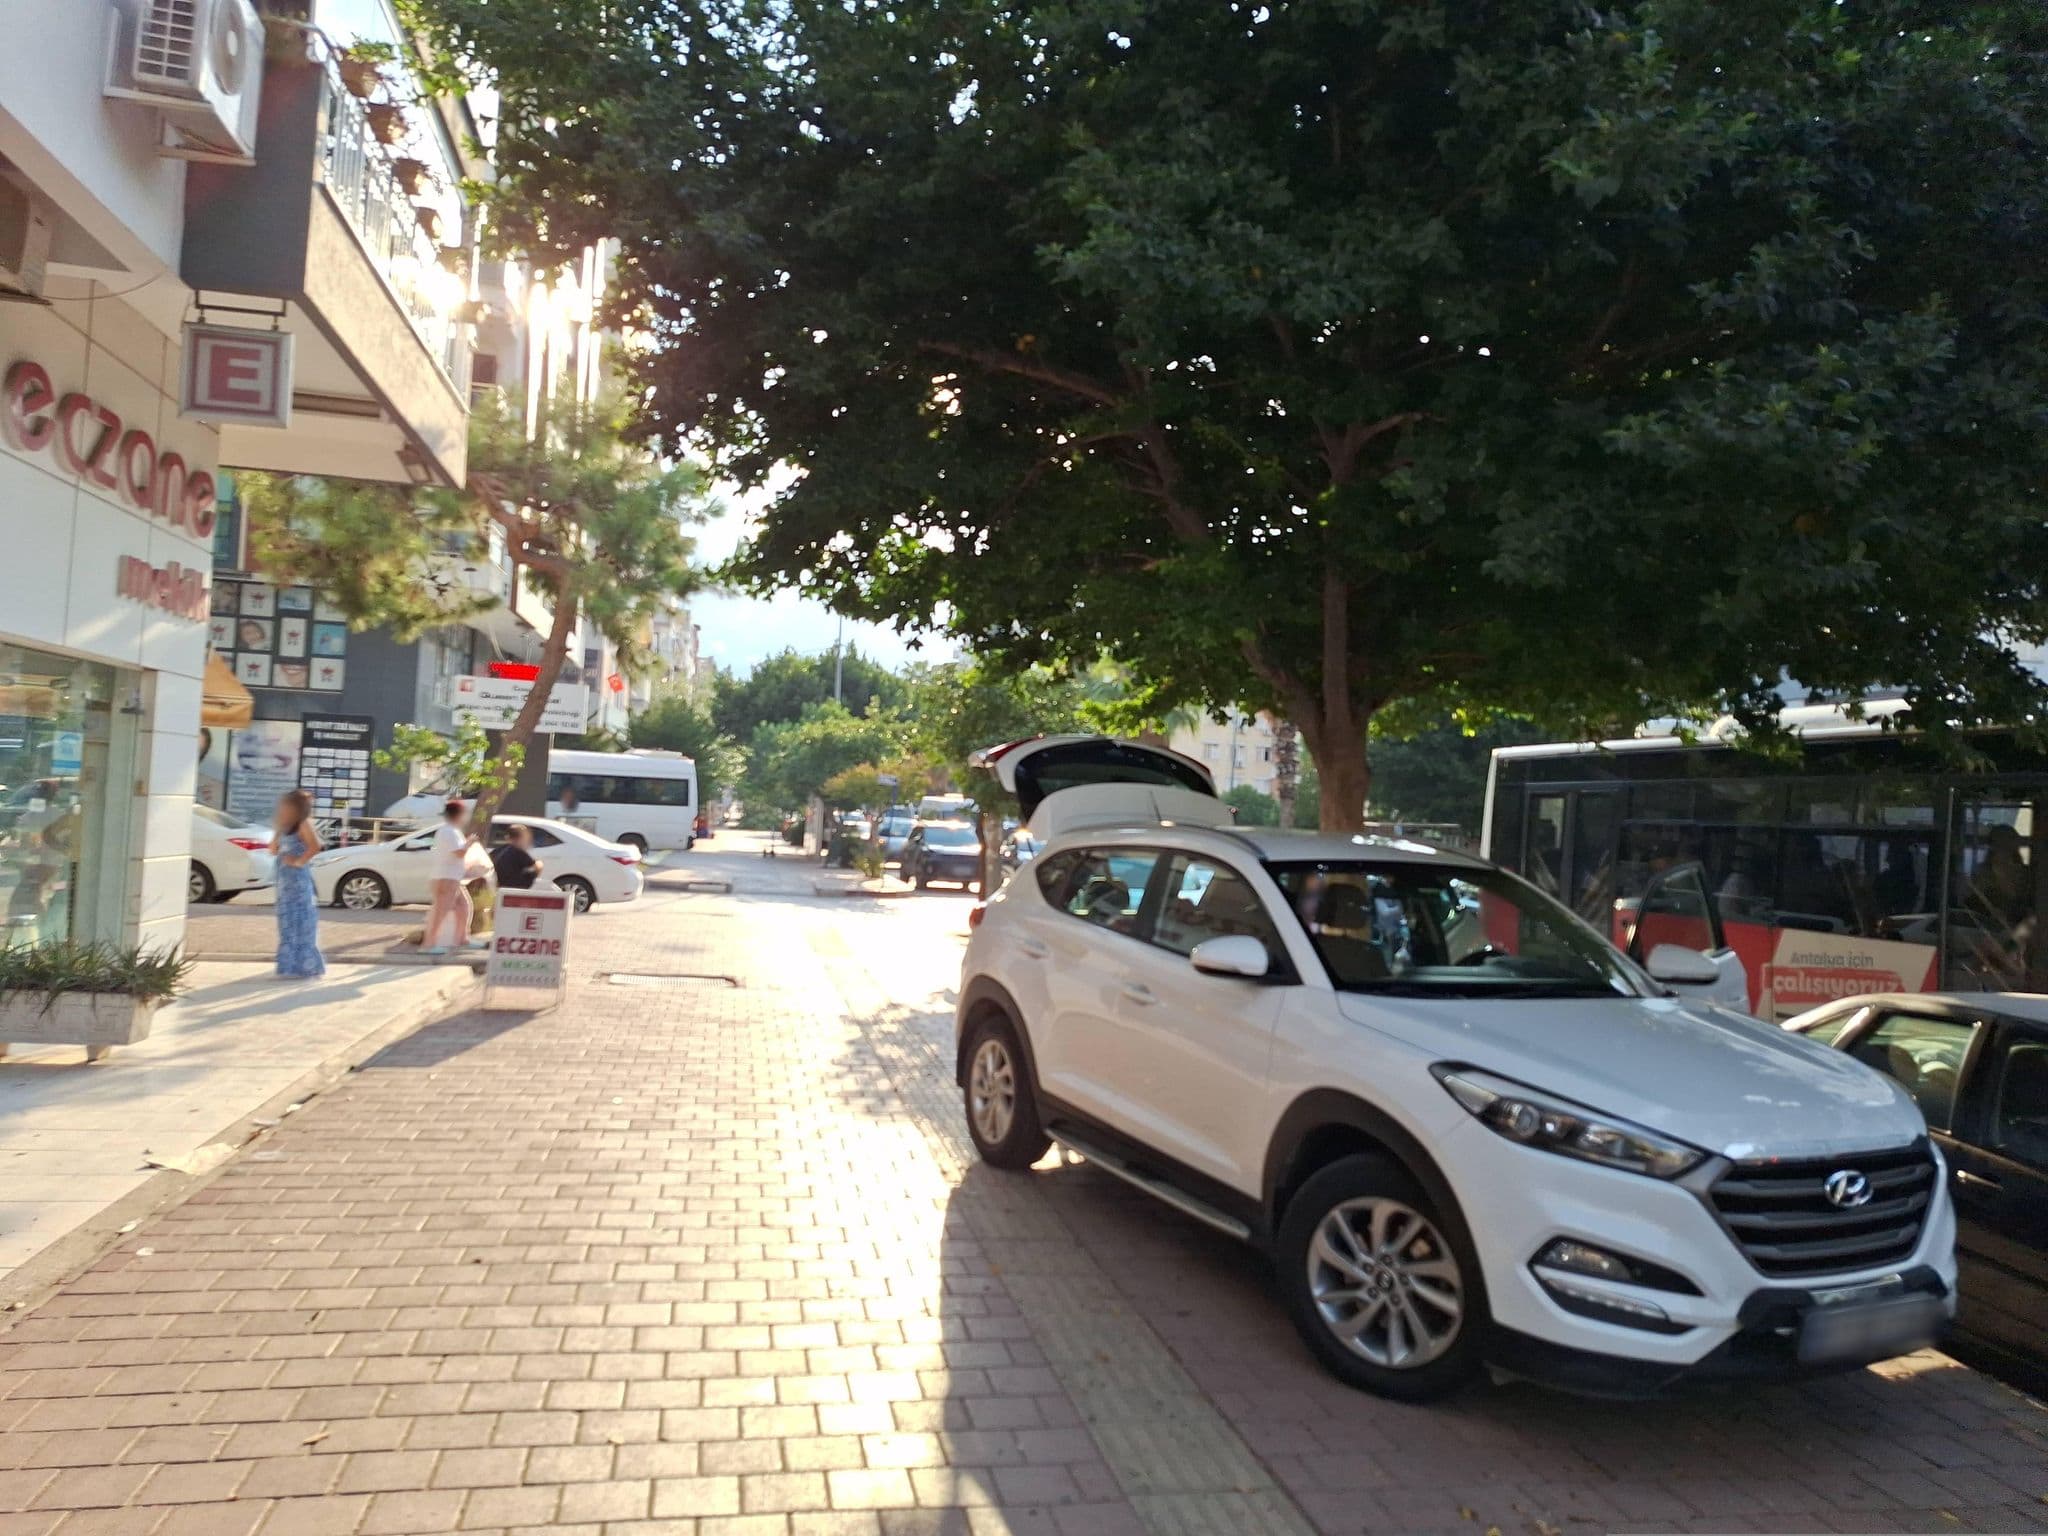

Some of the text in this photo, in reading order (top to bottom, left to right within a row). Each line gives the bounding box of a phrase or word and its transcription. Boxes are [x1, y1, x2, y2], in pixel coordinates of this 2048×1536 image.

[208, 345, 262, 404] E
[4, 360, 217, 538] eczane
[525, 915, 538, 930] E
[496, 936, 561, 956] eczane
[1790, 951, 1874, 968] Antalya için
